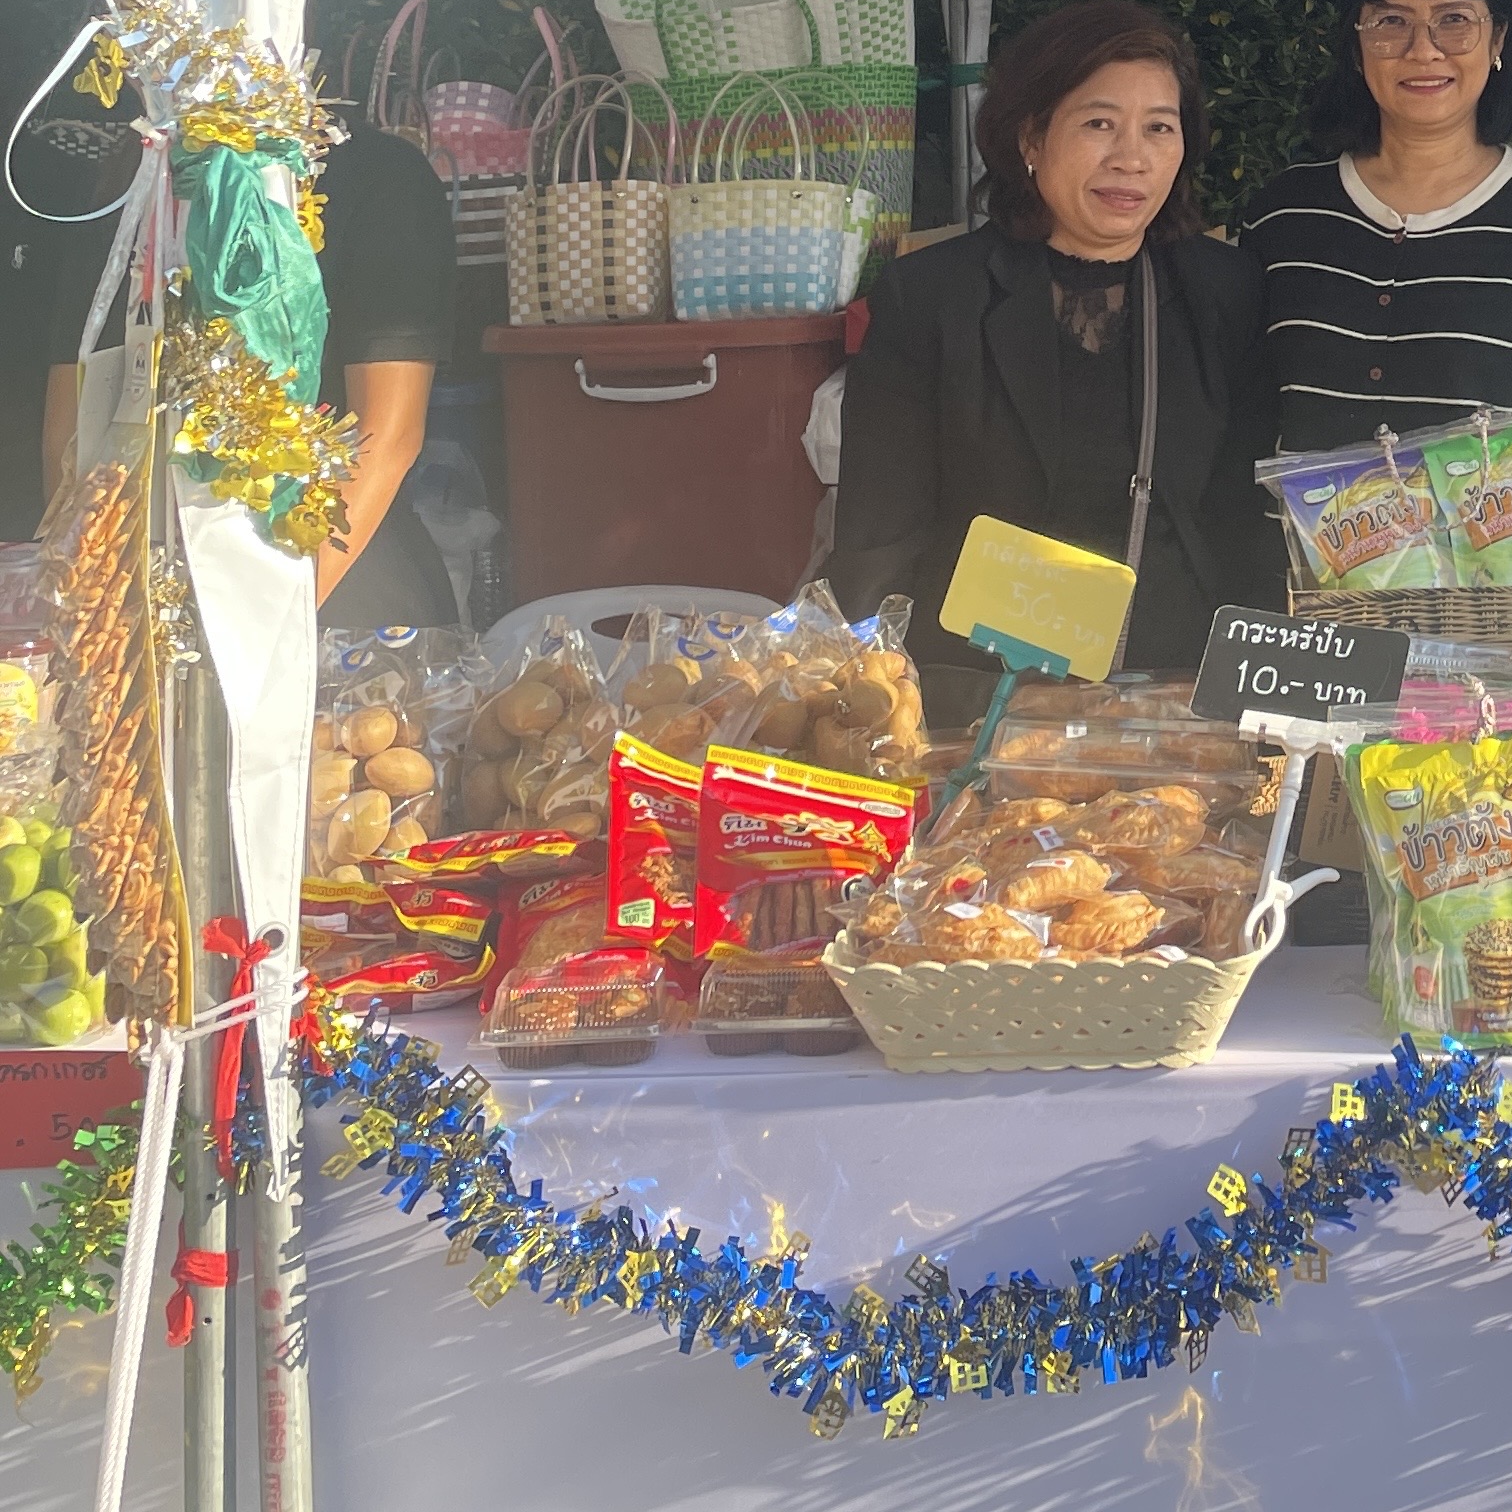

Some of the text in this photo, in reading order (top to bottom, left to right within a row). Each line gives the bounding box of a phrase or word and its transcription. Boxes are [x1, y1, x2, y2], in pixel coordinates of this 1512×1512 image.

[1322, 488, 1422, 553] ข้าวตัง
[1236, 660, 1367, 705] 10.- บาท
[723, 832, 770, 849] Kim
